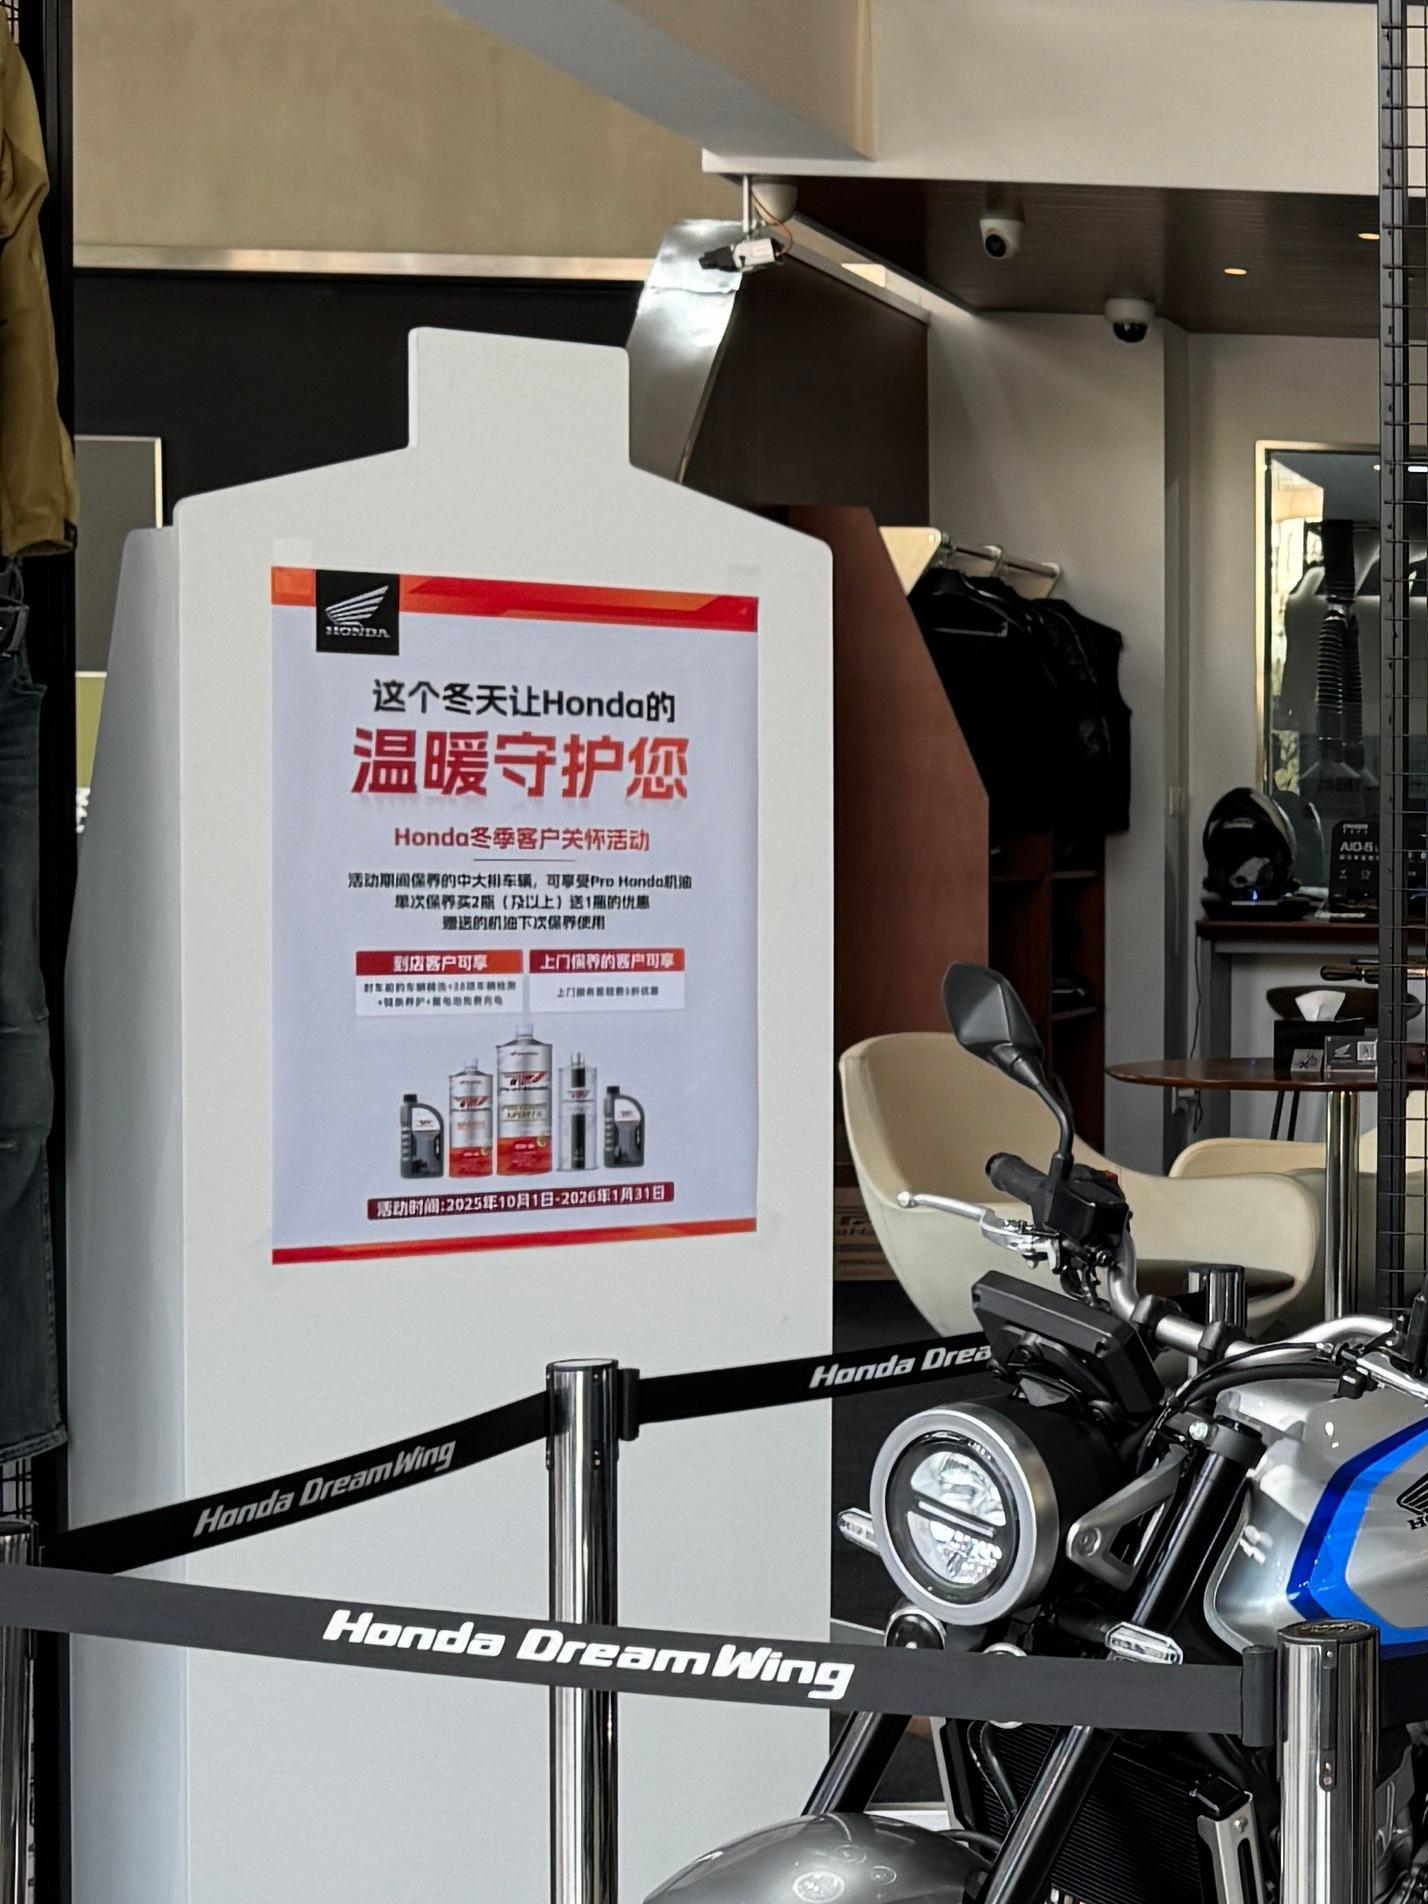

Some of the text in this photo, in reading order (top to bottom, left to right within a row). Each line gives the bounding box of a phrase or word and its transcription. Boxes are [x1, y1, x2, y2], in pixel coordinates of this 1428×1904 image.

[325, 624, 392, 640] HONDA
[372, 677, 677, 724] 这个冬天让Honda的
[350, 725, 690, 800] 温暖守护您
[394, 826, 651, 853] Honda冬季客户关怀活动
[392, 953, 489, 974] 到店客户可享
[539, 951, 676, 971] 上门保养的客户可享
[808, 1354, 916, 1389] Honda
[193, 1487, 295, 1539] Honda
[322, 1607, 504, 1660] Honda
